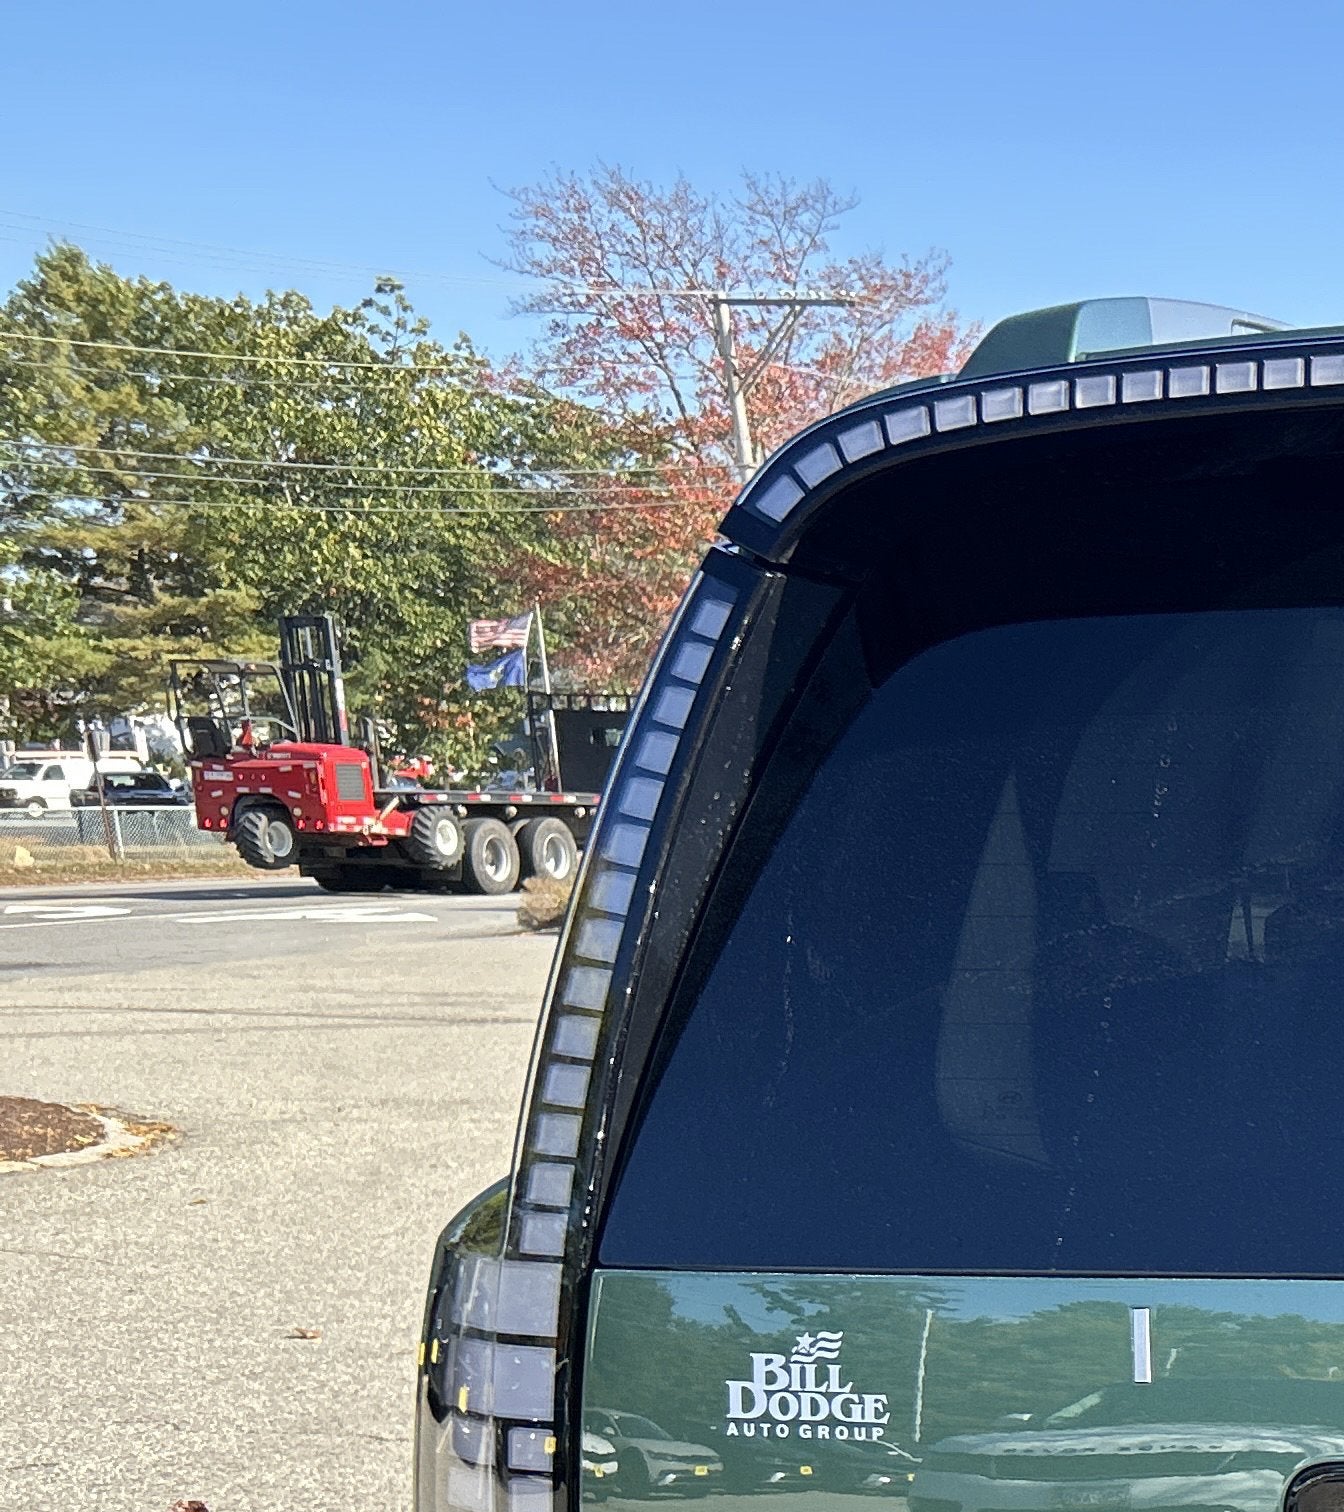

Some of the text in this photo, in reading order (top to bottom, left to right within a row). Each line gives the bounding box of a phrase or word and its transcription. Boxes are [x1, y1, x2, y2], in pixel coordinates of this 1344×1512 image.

[750, 1352, 854, 1393] BILL
[725, 1379, 891, 1425] DODGE
[726, 1422, 885, 1441] AUTO GROUP
